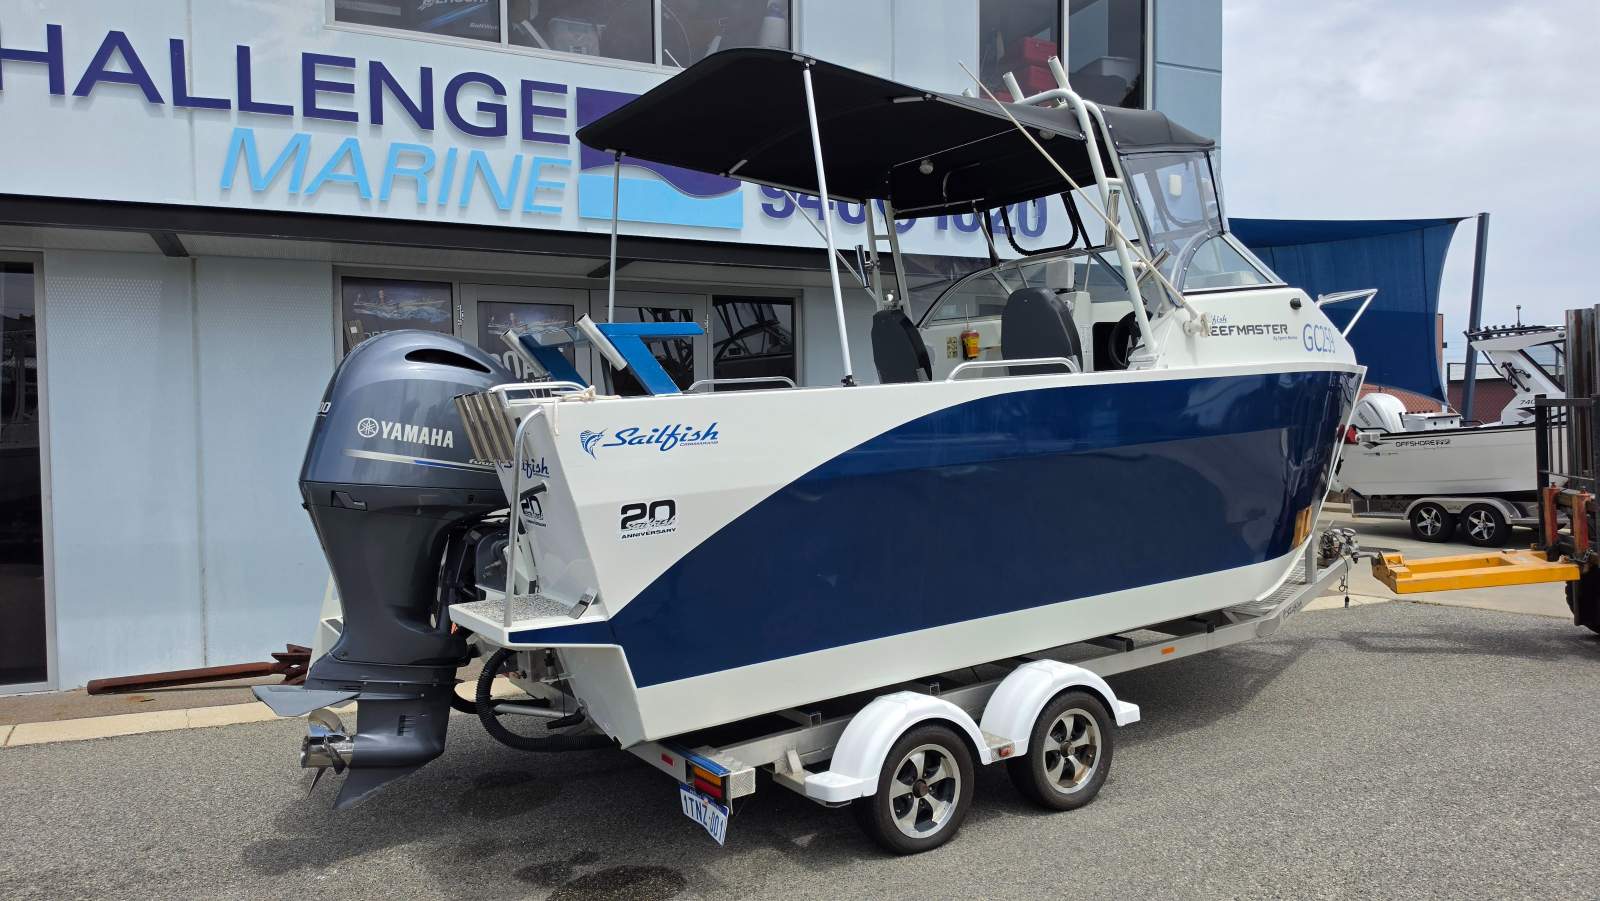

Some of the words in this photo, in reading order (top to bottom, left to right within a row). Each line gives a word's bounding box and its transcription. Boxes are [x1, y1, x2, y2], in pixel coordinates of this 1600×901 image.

[221, 127, 573, 215] MARINE
[1208, 323, 1289, 337] EEFMASTER
[381, 421, 454, 449] YAMAHA
[602, 422, 720, 451] Sailfish
[620, 499, 676, 530] 20
[621, 527, 677, 540] ANNIVERSARY
